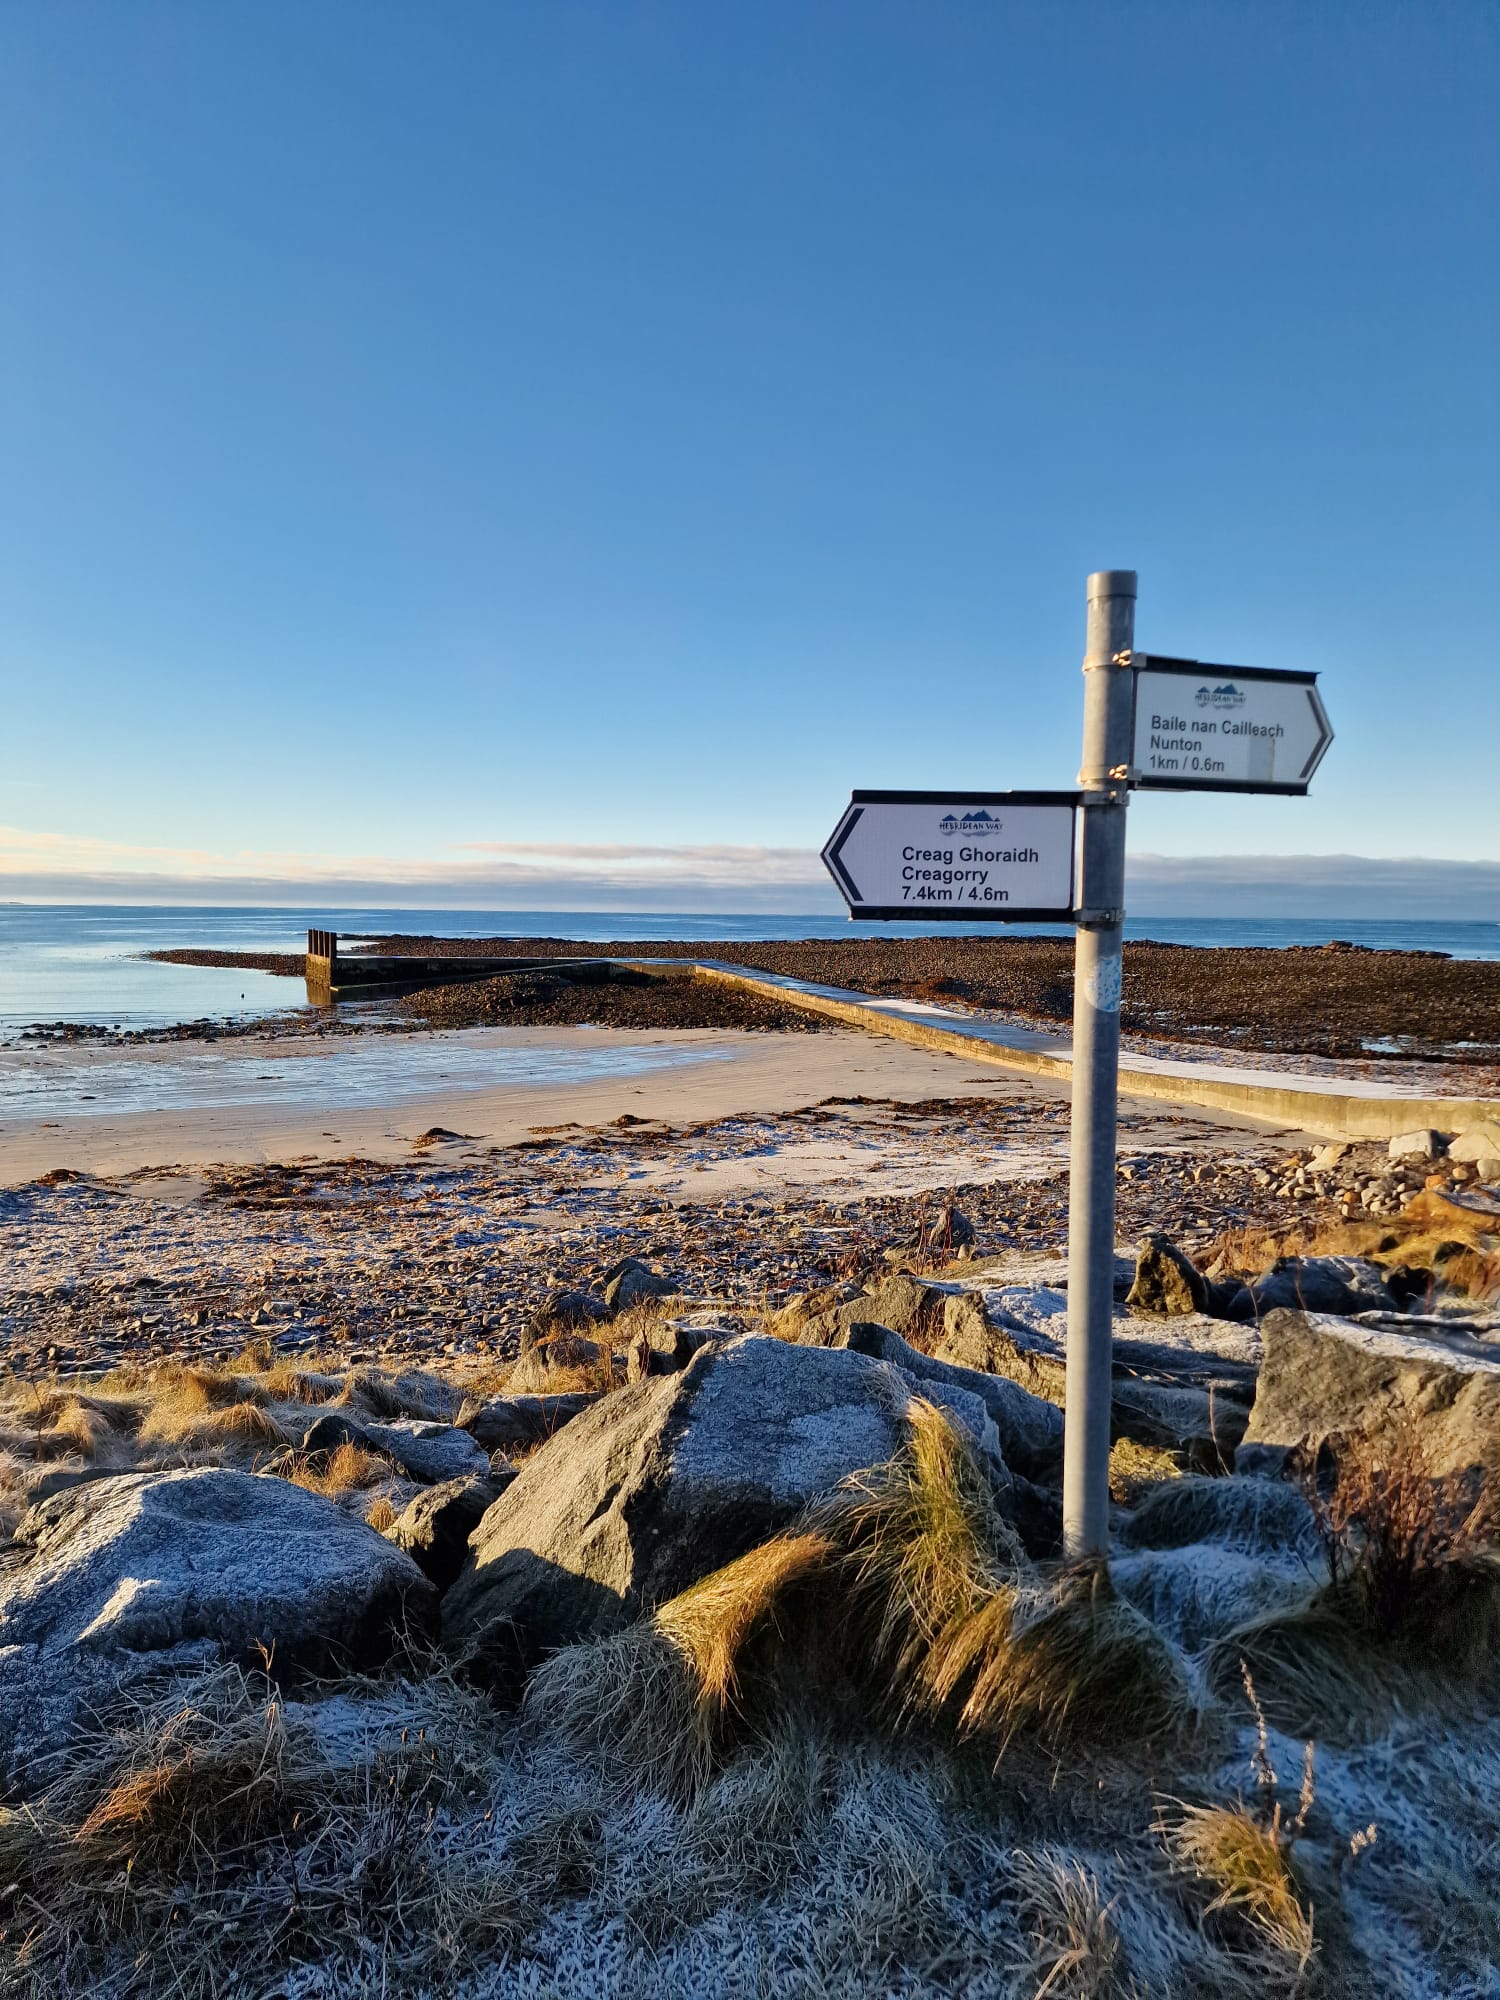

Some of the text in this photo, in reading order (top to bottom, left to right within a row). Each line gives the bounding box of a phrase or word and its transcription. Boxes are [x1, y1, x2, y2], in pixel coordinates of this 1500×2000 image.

[1151, 715, 1284, 738] Baile nan Cailleach
[1150, 735, 1202, 752] Nunton
[1149, 755, 1225, 772] 1km / 0.6m
[902, 846, 1039, 865] Creag Ghoraidh
[902, 866, 989, 885] Creagorry
[901, 886, 1009, 901] 7.4km / 4.6m
